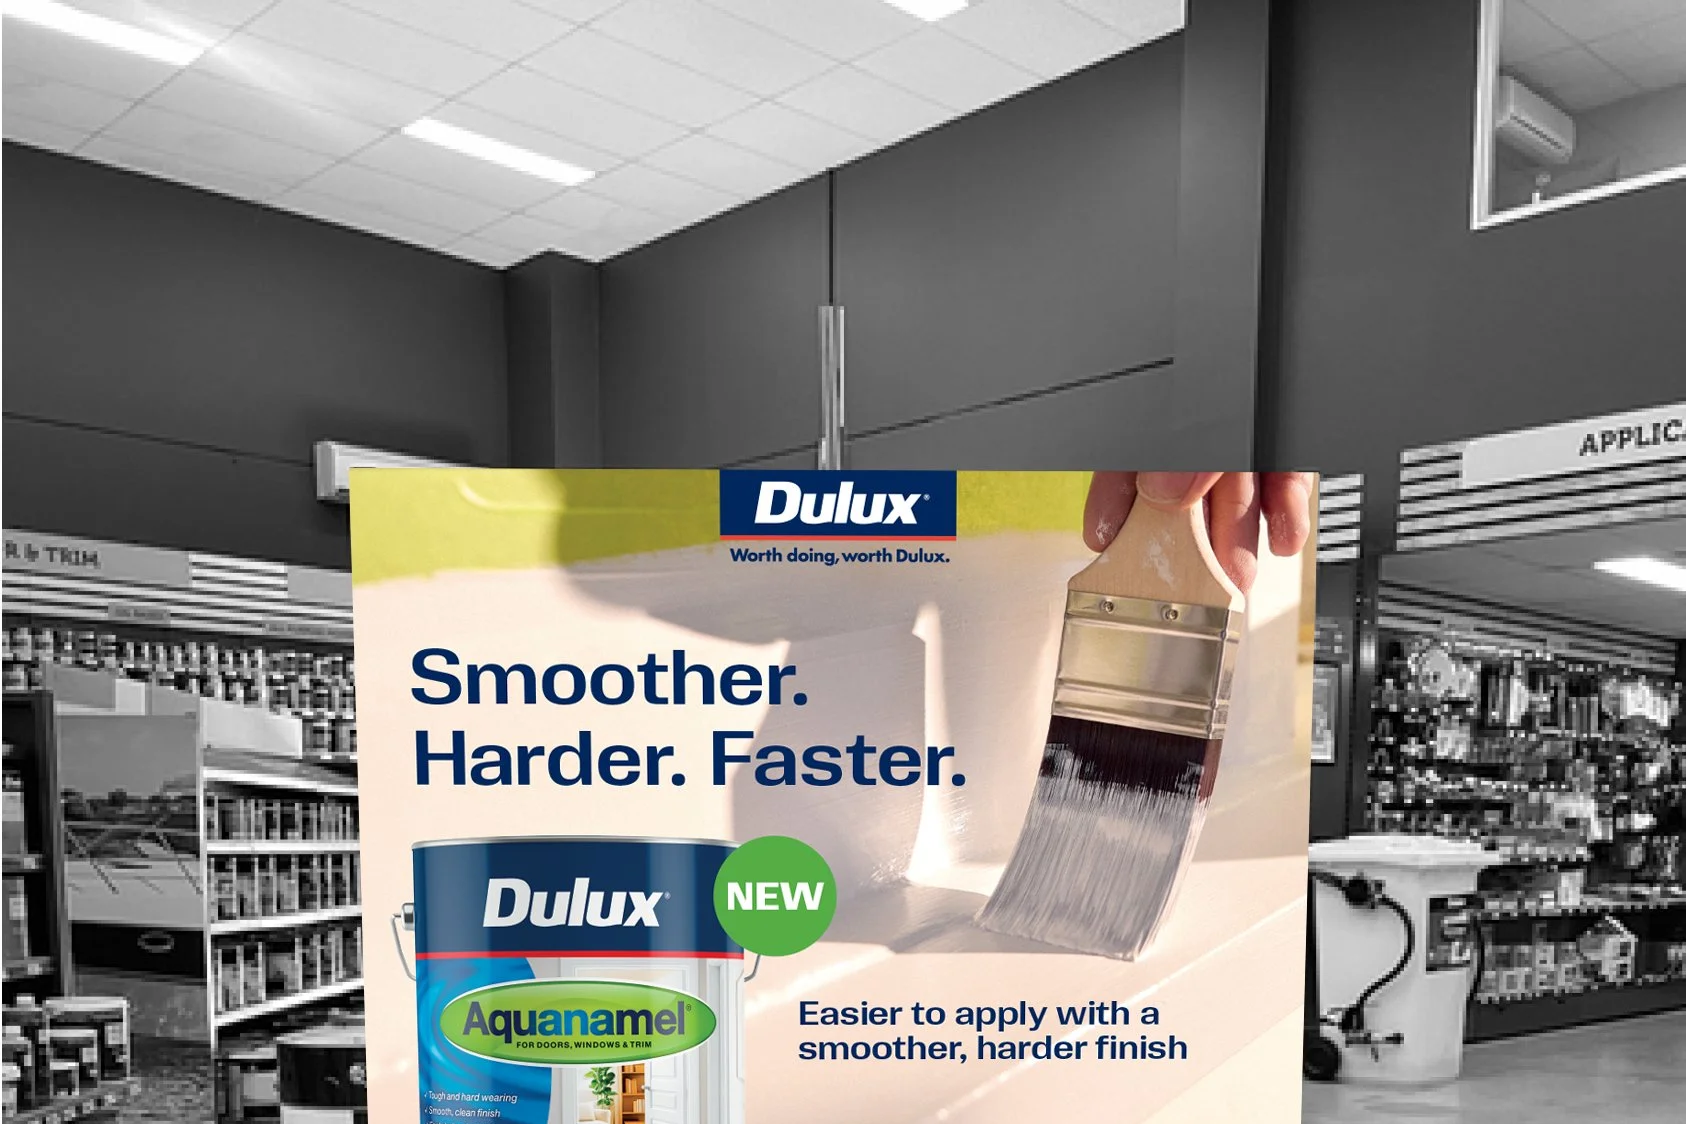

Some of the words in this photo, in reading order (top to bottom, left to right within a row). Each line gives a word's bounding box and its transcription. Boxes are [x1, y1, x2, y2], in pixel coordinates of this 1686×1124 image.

[1579, 418, 1686, 457] APPLIC
[730, 548, 783, 563] Worth
[787, 548, 839, 567] doing,
[842, 548, 892, 563] worth
[896, 548, 950, 563] Dulux.
[412, 647, 808, 706] Smoother.
[415, 730, 686, 787] Harder.
[712, 730, 966, 787] Faster.
[727, 881, 825, 911] NEW
[799, 1000, 903, 1026] Easier
[911, 1002, 946, 1026] to
[955, 1000, 1048, 1032] apply
[1056, 1000, 1130, 1026] with
[1140, 1007, 1159, 1026] a
[516, 1041, 535, 1049] FOR
[536, 1041, 573, 1050] DOORS,
[574, 1041, 621, 1049] WINDOWS
[623, 1041, 628, 1049] &
[630, 1041, 652, 1049] TRIM
[798, 1035, 967, 1064] smoother,
[977, 1035, 1088, 1060] harder
[1095, 1035, 1187, 1060] finish
[428, 1106, 454, 1117] Smooth,
[454, 1108, 476, 1117] clean
[477, 1108, 501, 1118] finish
[446, 1092, 460, 1101] and
[461, 1093, 480, 1102] hard
[481, 1093, 518, 1104] wearing
